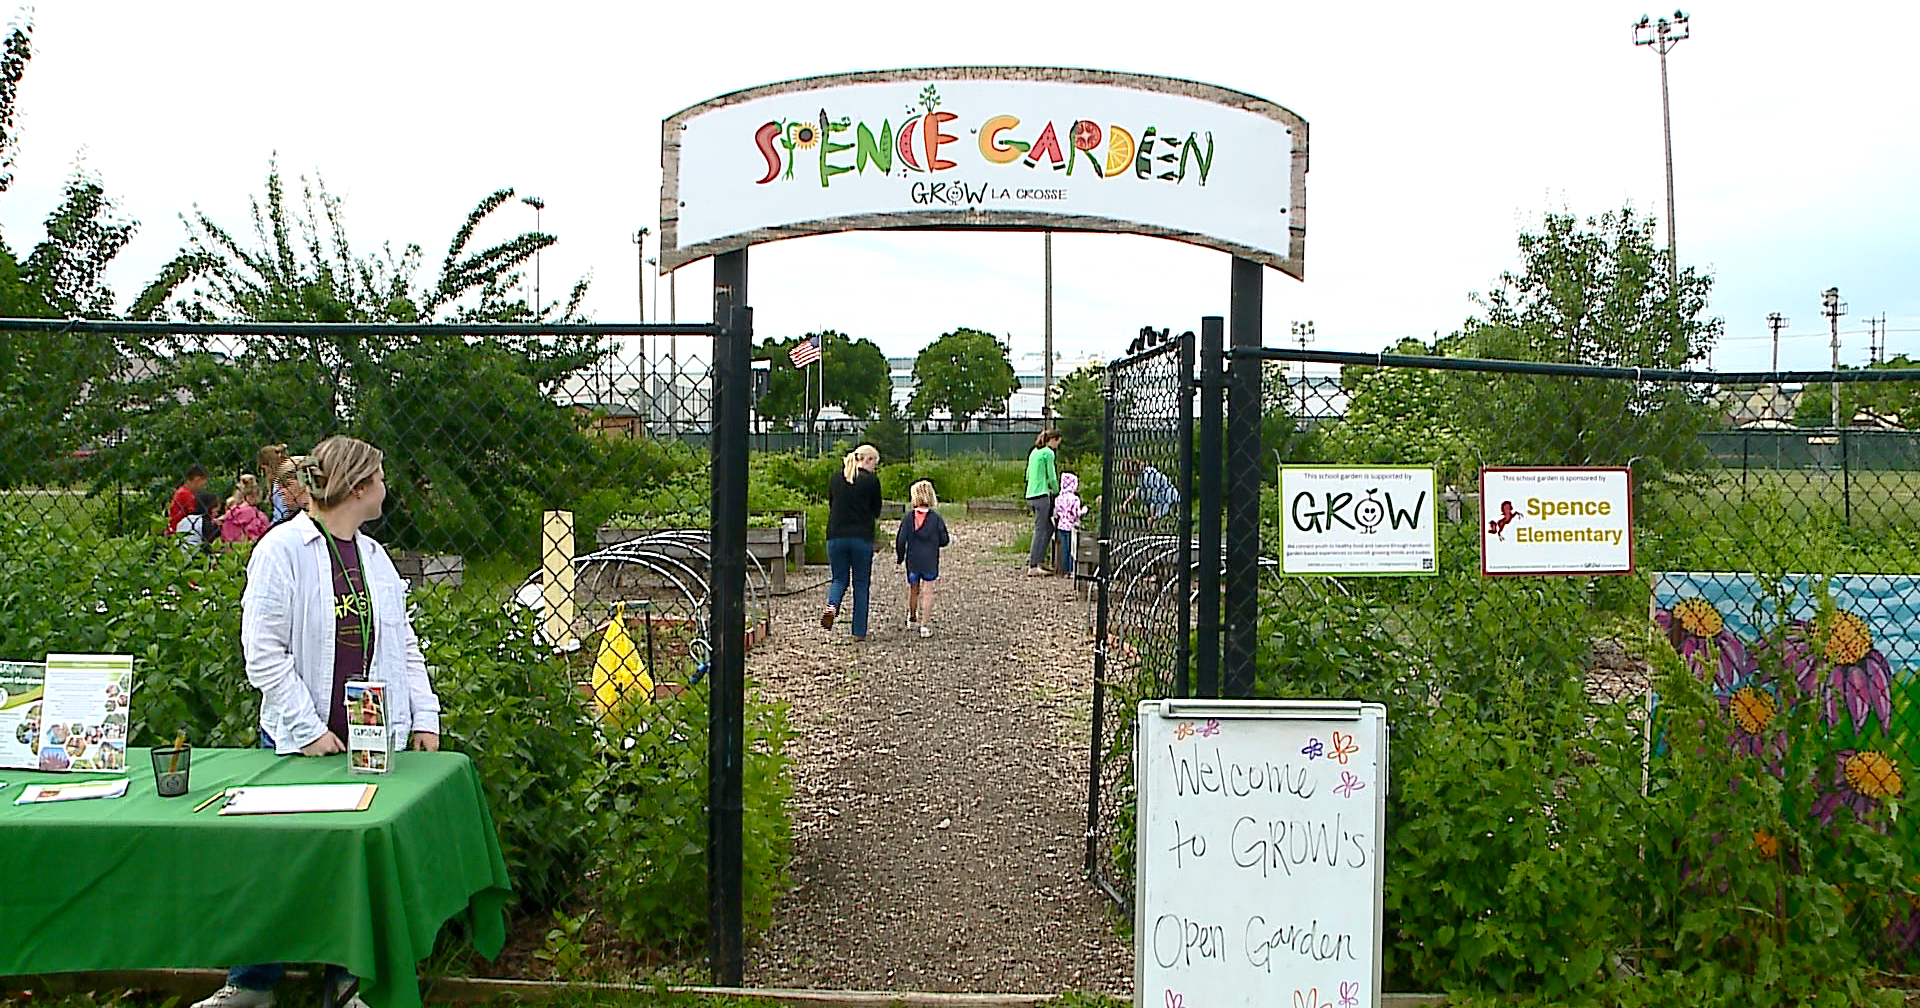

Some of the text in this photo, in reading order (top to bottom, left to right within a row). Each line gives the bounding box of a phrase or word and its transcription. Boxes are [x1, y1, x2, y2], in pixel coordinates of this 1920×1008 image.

[755, 86, 1214, 188] SPENCE GARDEN
[911, 181, 1068, 205] GROW LA CROSSE
[1341, 473, 1363, 481] garden
[1371, 473, 1404, 481] supported
[1405, 473, 1413, 481] by
[1537, 475, 1559, 483] garden
[1566, 475, 1598, 483] sponsored
[1599, 475, 1607, 483] by
[1292, 488, 1426, 534] GROW
[1527, 498, 1611, 520] Spence
[1516, 527, 1623, 546] Elementary
[1169, 743, 1317, 799] Welcome
[1169, 812, 1366, 878] to GROW's
[1153, 913, 1358, 973] Open Garden
